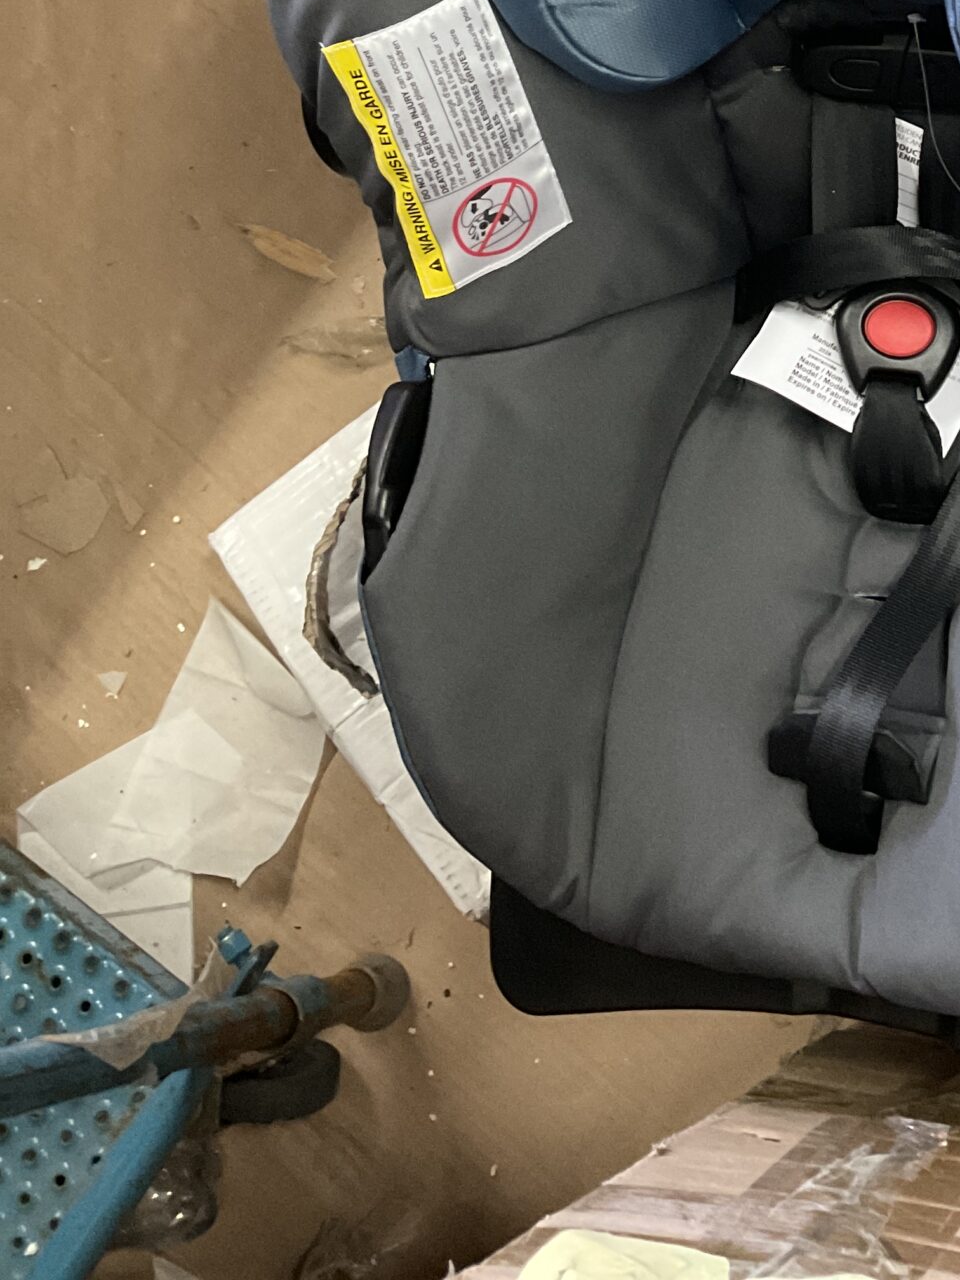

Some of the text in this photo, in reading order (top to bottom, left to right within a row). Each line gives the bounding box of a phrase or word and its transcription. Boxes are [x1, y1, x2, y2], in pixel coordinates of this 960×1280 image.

[390, 38, 409, 70] children
[455, 46, 476, 84] GRAVES,
[400, 89, 419, 120] INJURY
[469, 83, 494, 131] BLESSURES
[412, 119, 434, 156] SERIOUS
[348, 67, 436, 255] WARNING MISE EN GARDE
[427, 155, 439, 169] OR
[465, 150, 478, 167] PAS
[471, 166, 483, 179] NE
[413, 172, 426, 189] NOT
[433, 168, 450, 195] DEATH
[458, 175, 468, 185] 12
[419, 188, 431, 201] DO
[795, 362, 819, 378] Model
[823, 377, 850, 395] Modèle
[799, 355, 821, 371] Name
[825, 370, 843, 383] Nom
[787, 376, 816, 395] Expires
[816, 392, 827, 400] on
[792, 369, 812, 383] Made
[812, 380, 821, 388] in
[825, 387, 858, 408] Fabriqué
